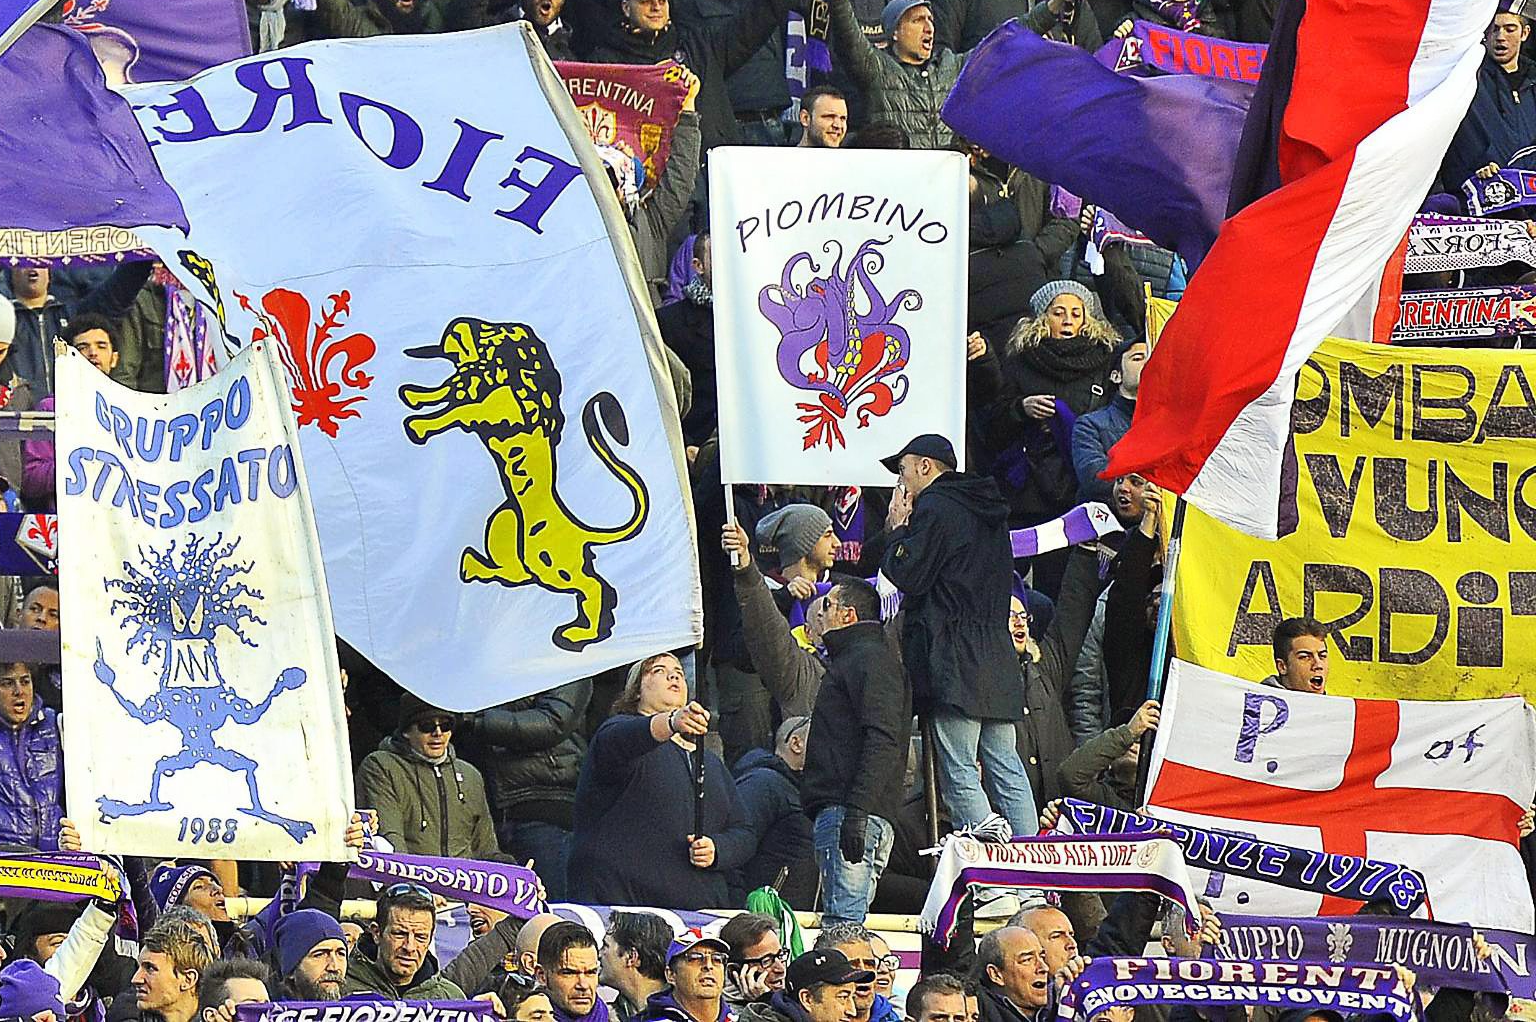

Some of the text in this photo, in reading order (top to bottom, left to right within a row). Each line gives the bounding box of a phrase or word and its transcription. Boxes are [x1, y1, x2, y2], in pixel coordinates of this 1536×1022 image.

[735, 192, 949, 252] PIOMBINO
[94, 374, 252, 464] GRUPPO
[65, 442, 299, 530] STRESSATO
[177, 817, 239, 845] 1988
[985, 842, 1026, 864] VIOLA
[1028, 842, 1062, 864] CLUB
[1064, 844, 1098, 866] ALFA
[1299, 852, 1425, 911] 1978
